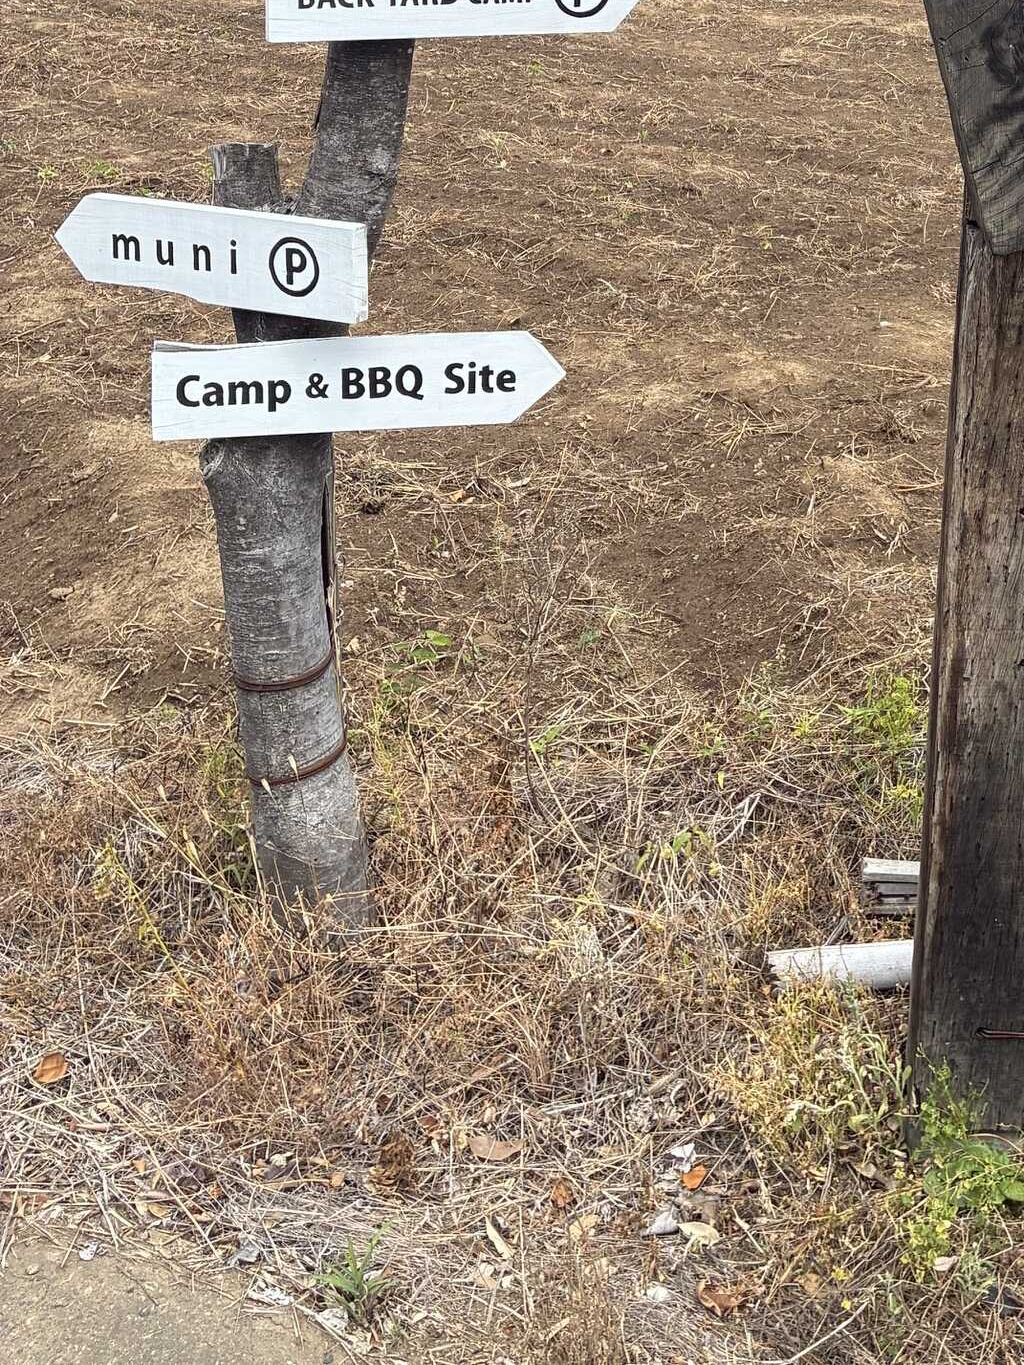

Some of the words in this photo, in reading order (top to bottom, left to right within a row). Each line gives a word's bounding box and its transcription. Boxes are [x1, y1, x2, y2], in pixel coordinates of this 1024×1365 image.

[111, 232, 238, 275] muni
[175, 374, 292, 413] Camp
[305, 372, 330, 399] &
[341, 364, 424, 401] BBQ
[444, 361, 517, 395] Site
